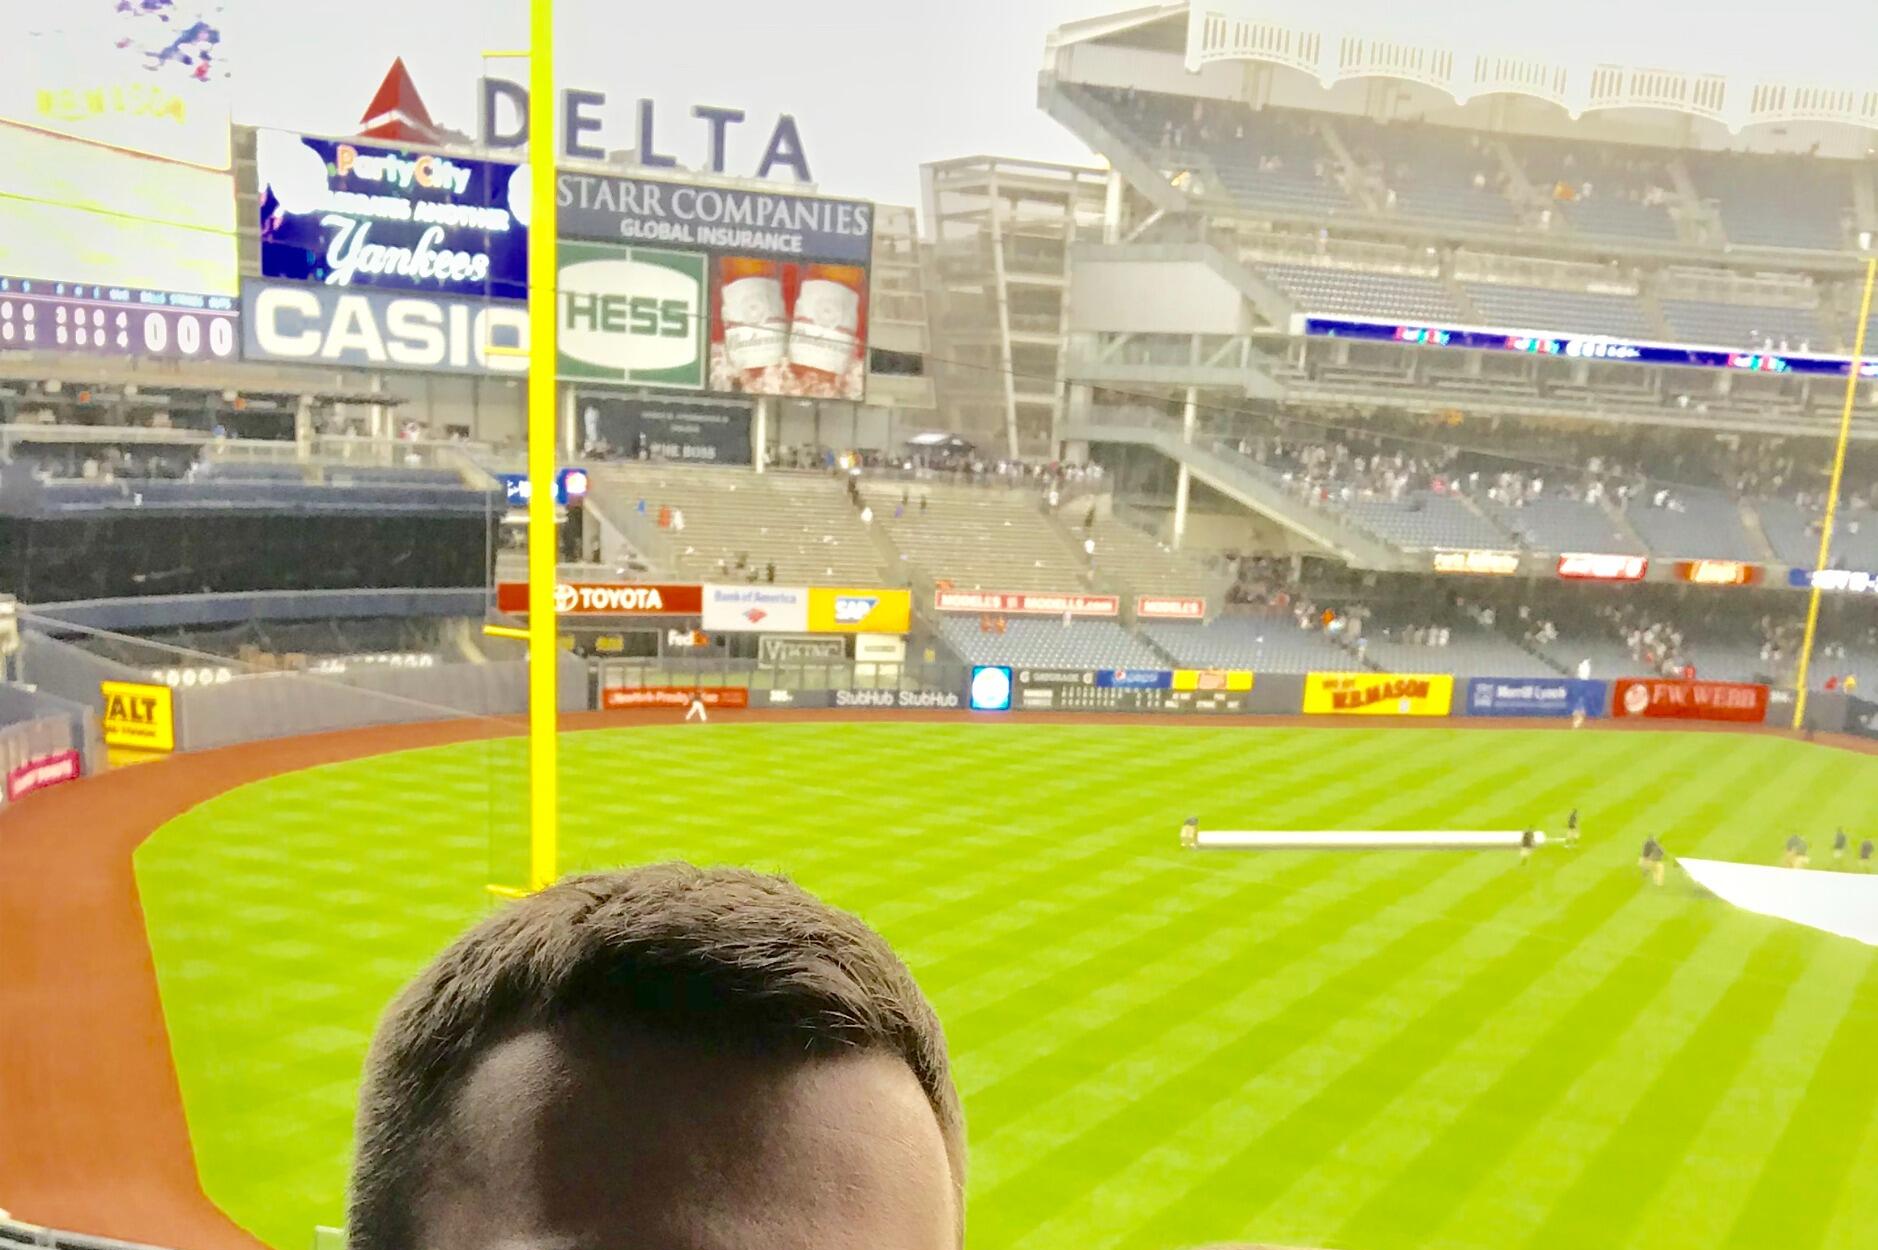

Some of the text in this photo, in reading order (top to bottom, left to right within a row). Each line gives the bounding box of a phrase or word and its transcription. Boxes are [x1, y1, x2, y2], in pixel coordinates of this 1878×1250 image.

[478, 76, 812, 183] DELTA
[336, 144, 415, 188] Party
[556, 174, 664, 217] STARR
[671, 187, 869, 236] COMPANIES
[320, 215, 490, 286] Yankees
[620, 218, 803, 253] GLOBAL INSURANCE
[255, 287, 530, 373] CASIO
[566, 292, 688, 338] HESS
[578, 588, 662, 609] TOYOTA
[835, 600, 871, 620] SAP
[836, 690, 959, 707] StubHub StubHub
